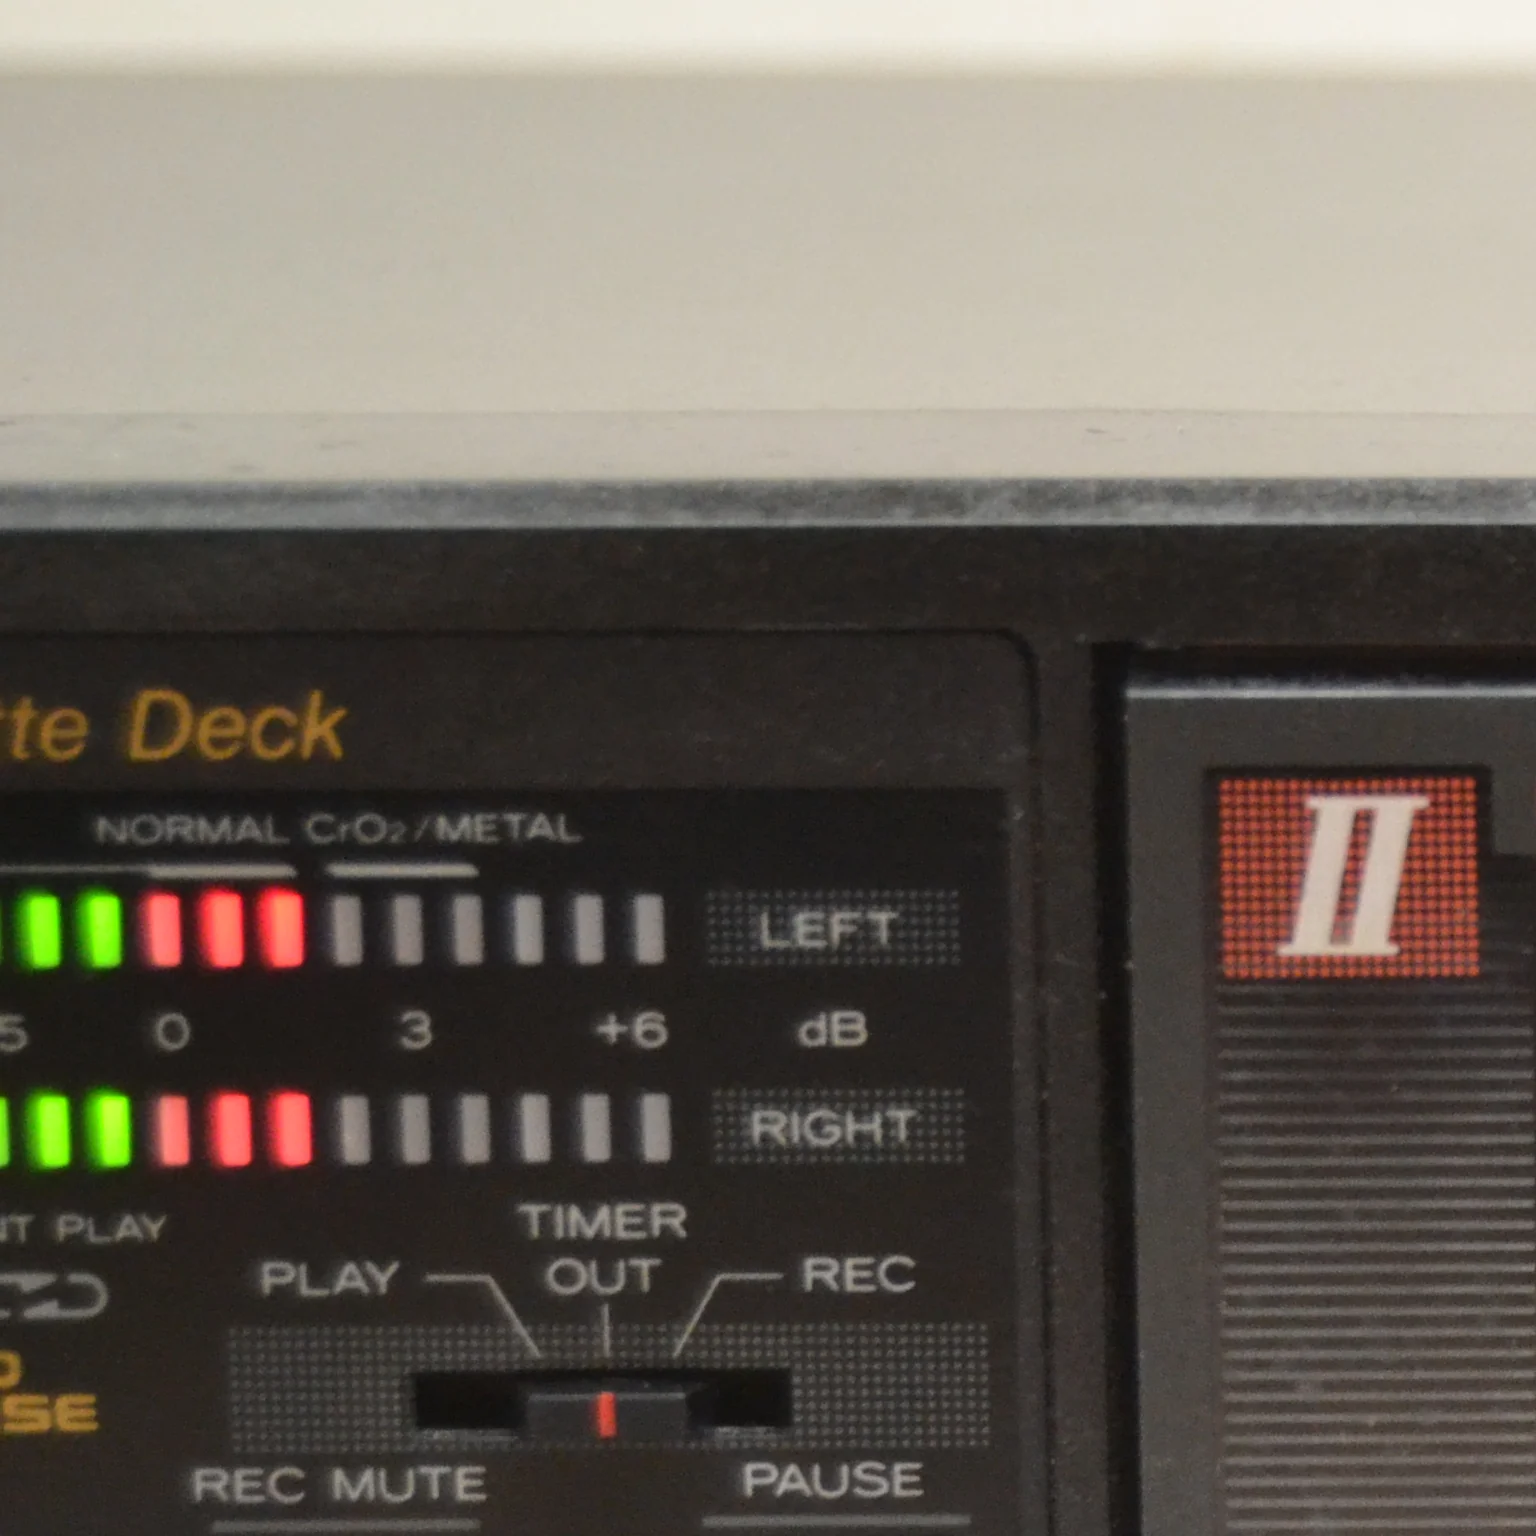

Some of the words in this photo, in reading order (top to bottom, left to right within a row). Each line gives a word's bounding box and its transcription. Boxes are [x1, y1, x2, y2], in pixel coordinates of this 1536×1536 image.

[0, 695, 88, 761] te
[128, 688, 347, 761] Deck
[96, 814, 290, 845] NORMAL
[758, 911, 899, 950] LEFT
[154, 1011, 191, 1052] 0
[400, 1010, 434, 1051] 3
[597, 1010, 670, 1049] +6
[798, 1011, 868, 1047] dB
[750, 1109, 917, 1148] RIGHT
[57, 1213, 168, 1244] PLAY
[517, 1203, 687, 1240] TIMER
[260, 1261, 401, 1296] PLAY
[543, 1257, 663, 1294] OUT
[802, 1255, 917, 1292] REC
[191, 1467, 306, 1504] REC
[331, 1465, 488, 1502] MUTE
[743, 1461, 925, 1498] PAUSE
